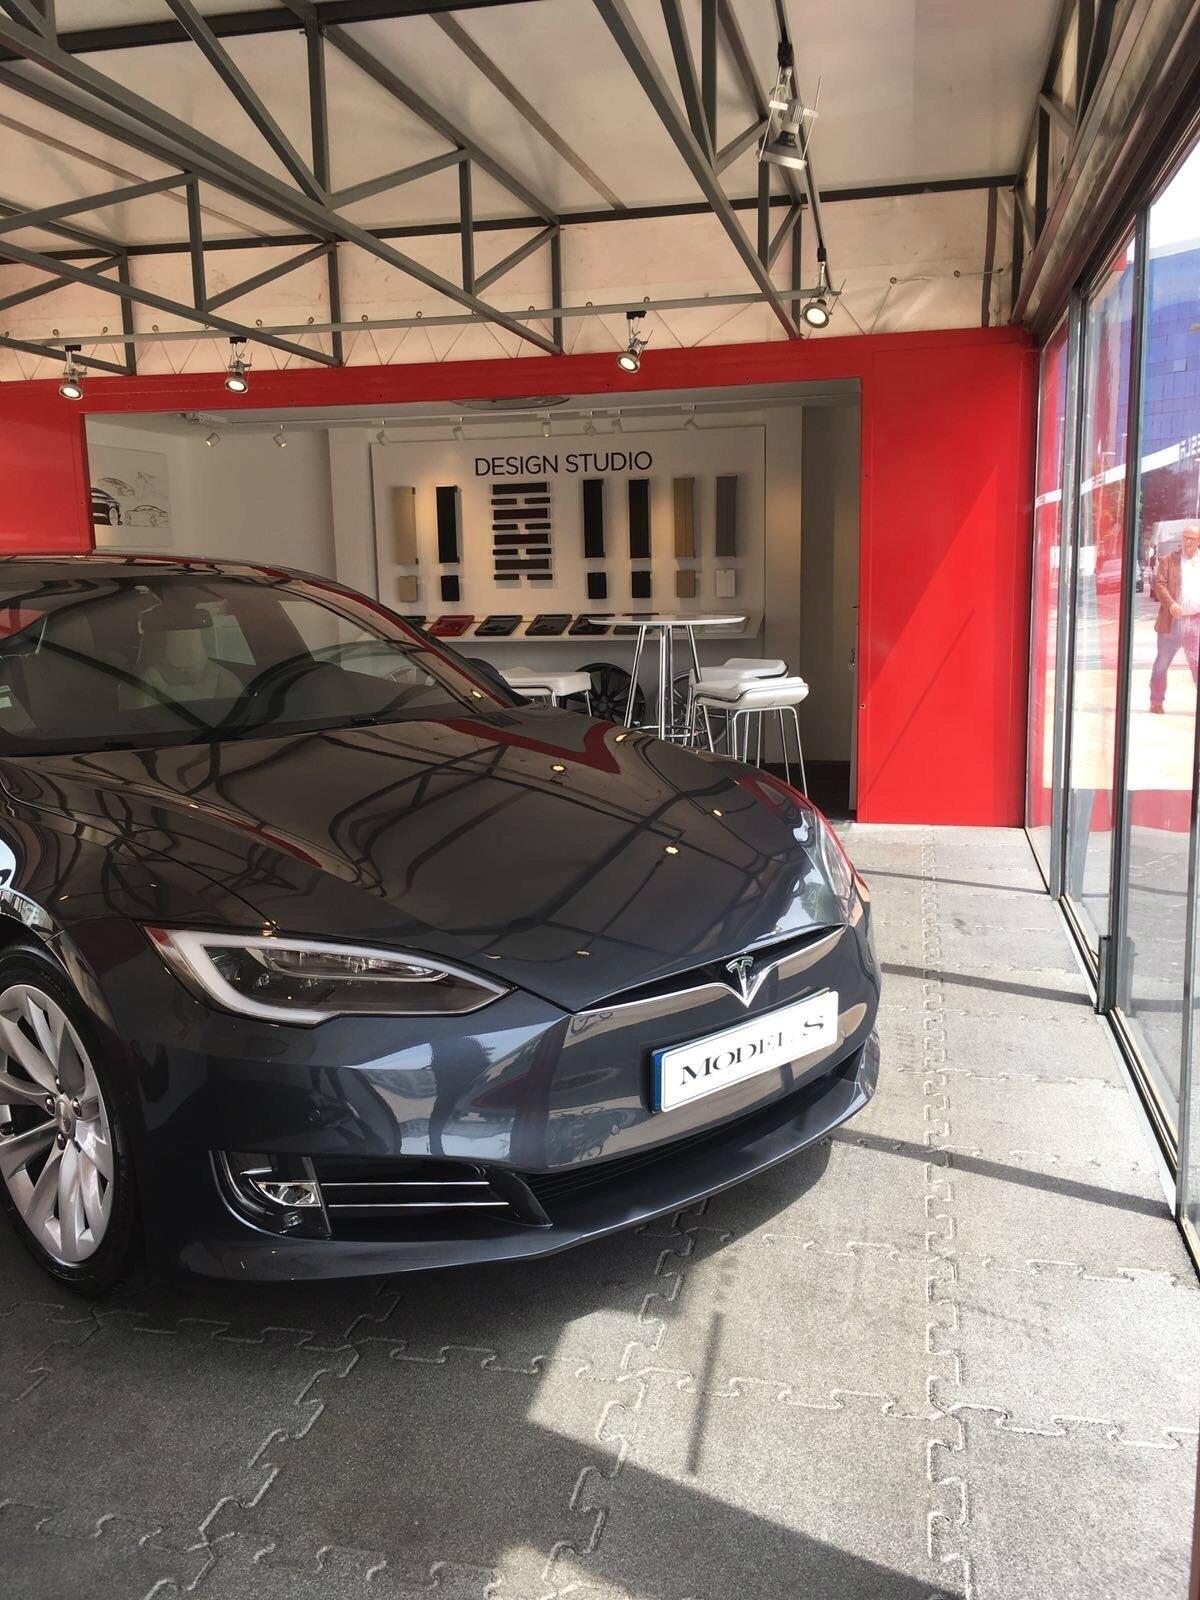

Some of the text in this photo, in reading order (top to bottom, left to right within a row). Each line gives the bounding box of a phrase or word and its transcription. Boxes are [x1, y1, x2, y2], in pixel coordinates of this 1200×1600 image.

[475, 451, 653, 476] DESIGN STUDIO
[803, 1015, 825, 1037] S
